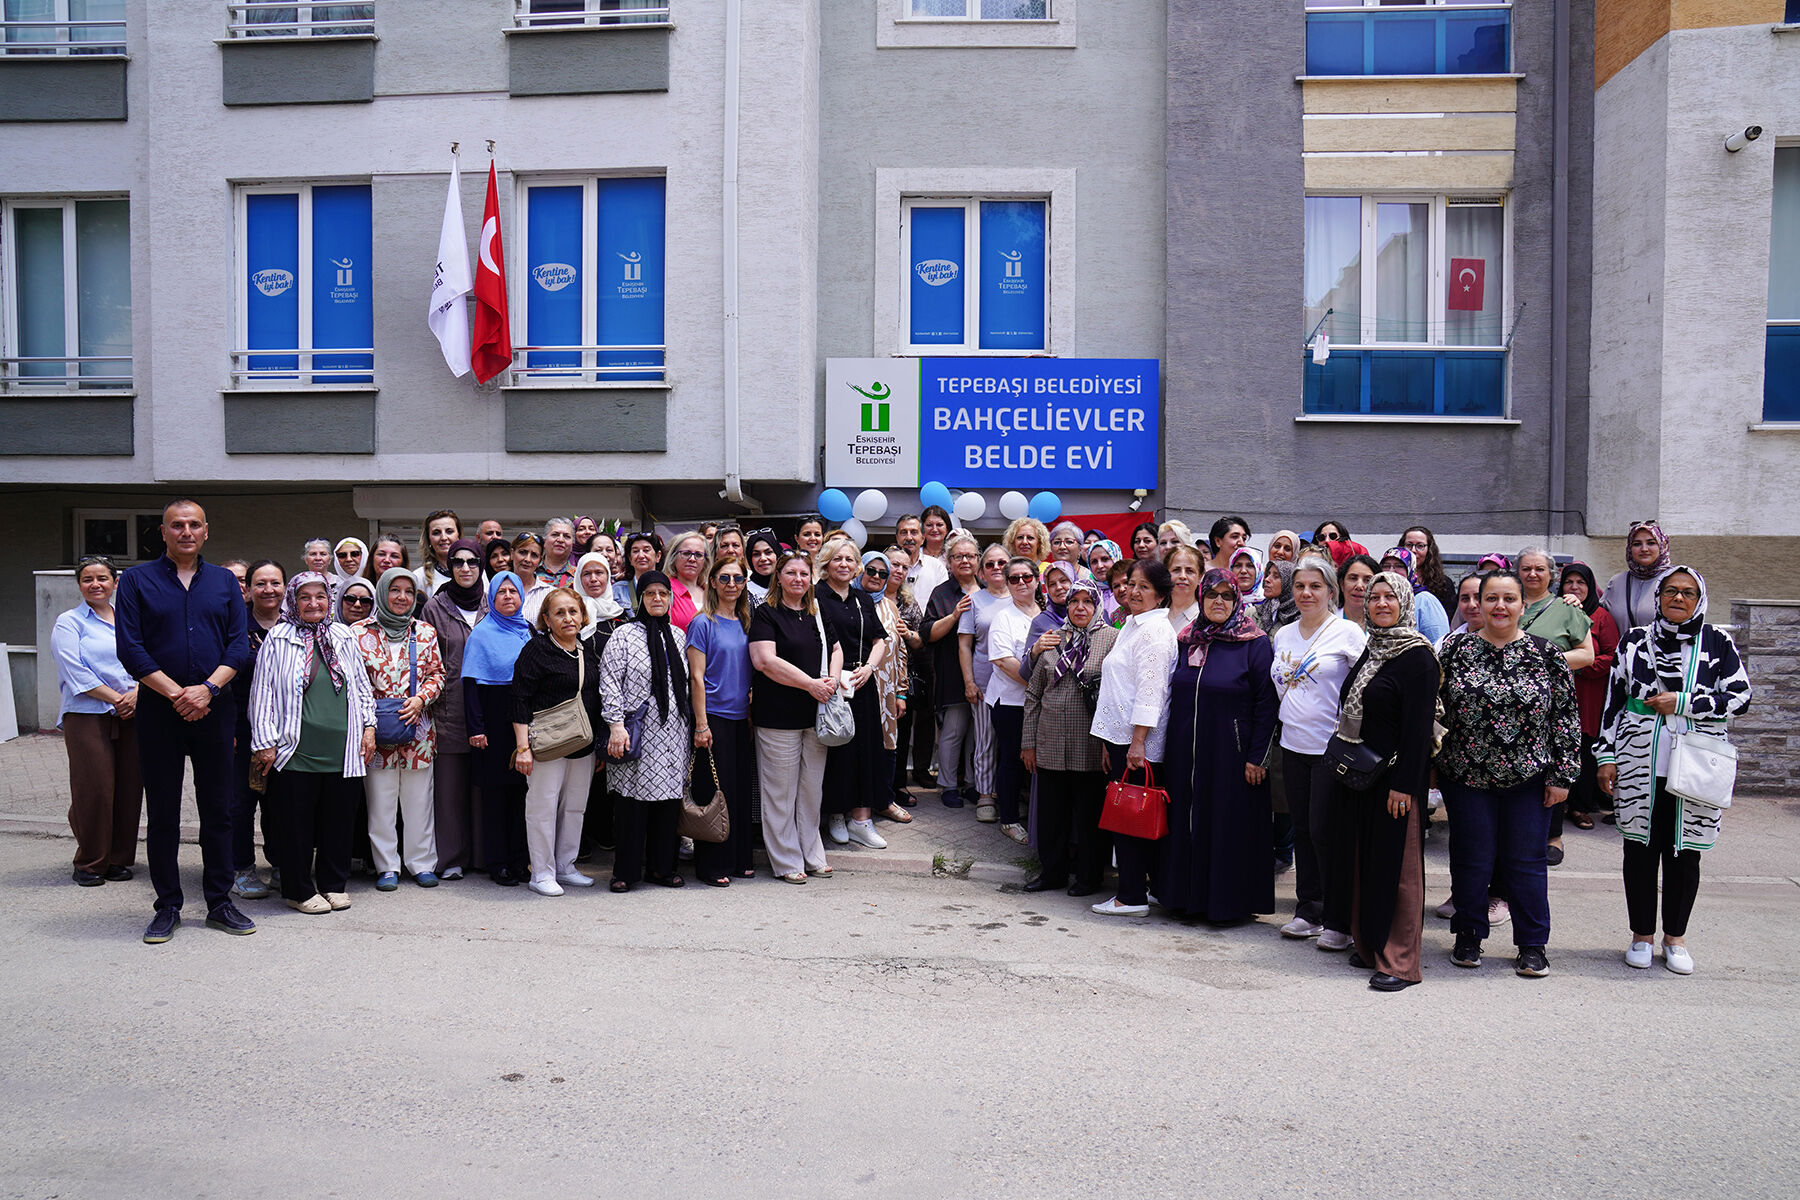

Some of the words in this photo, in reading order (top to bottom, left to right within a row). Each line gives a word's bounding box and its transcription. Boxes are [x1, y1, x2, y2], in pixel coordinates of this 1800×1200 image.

[533, 266, 570, 280] Kentine
[915, 263, 952, 275] Kentine
[253, 272, 288, 285] Kentine
[275, 279, 293, 290] bak!
[556, 274, 576, 285] bak!
[937, 377, 1029, 397] TEPEBAŞI
[1034, 375, 1142, 394] BELEDİYESİ
[933, 402, 1145, 437] BAHÇELİEVLER
[847, 443, 902, 457] TEPEBAŞI
[964, 445, 1056, 470] BELDE
[1066, 440, 1113, 470] EVİ
